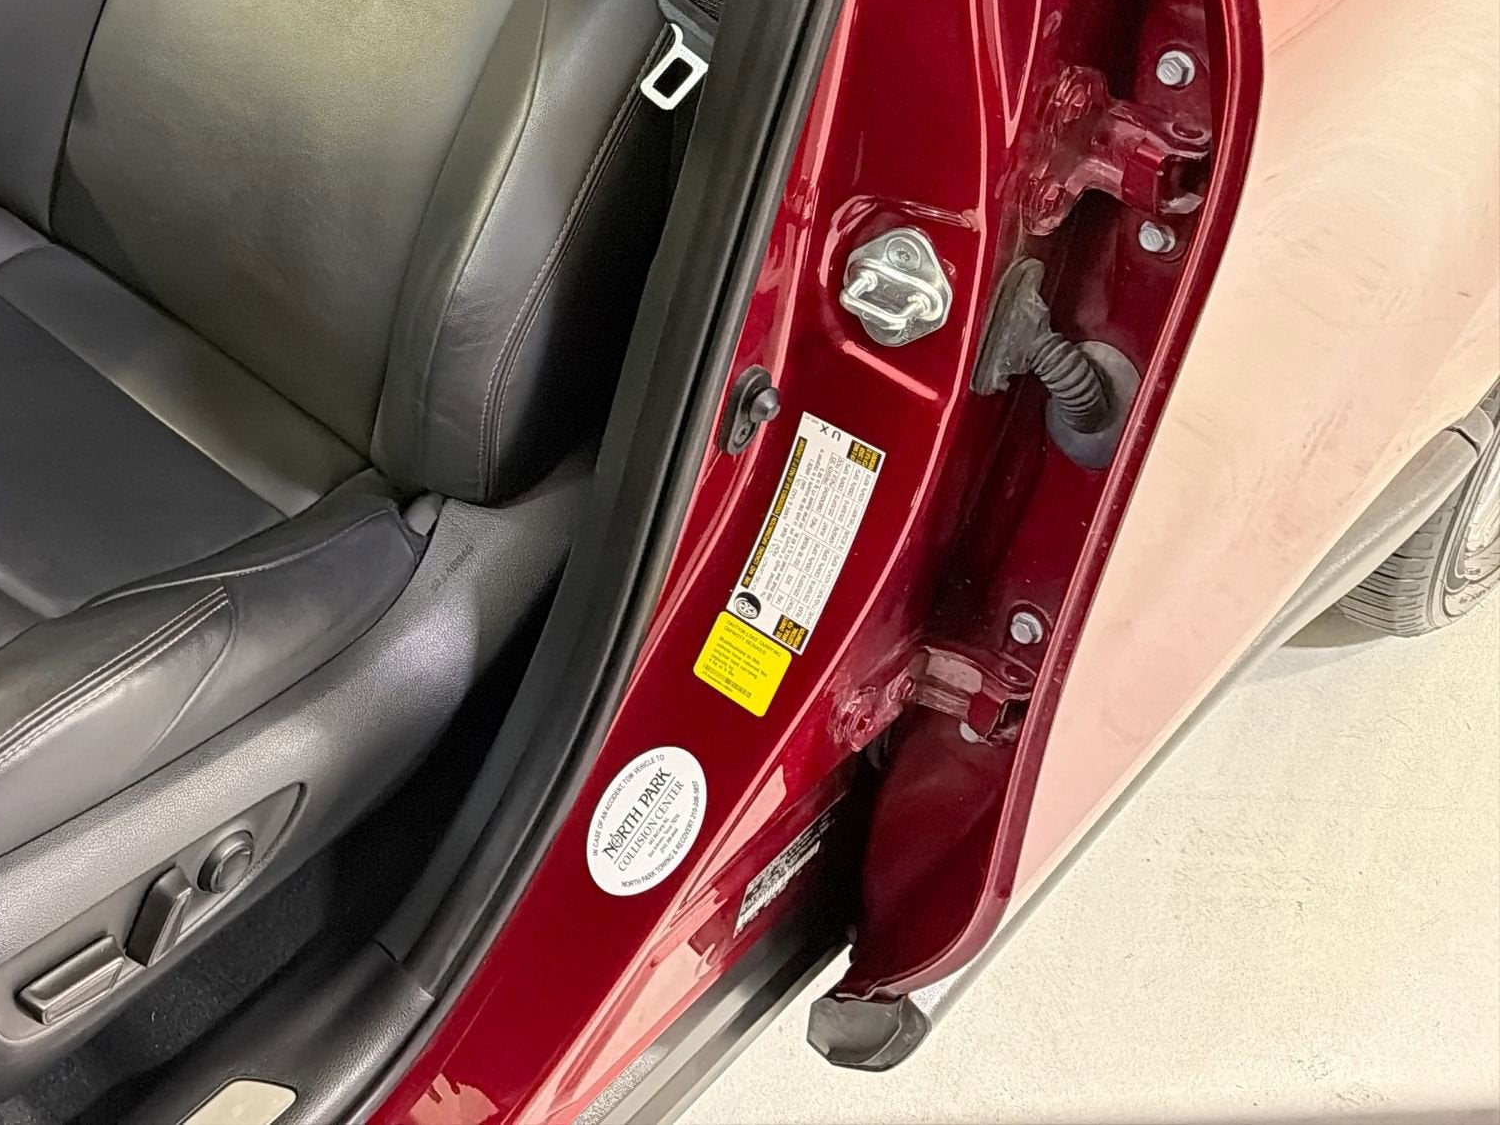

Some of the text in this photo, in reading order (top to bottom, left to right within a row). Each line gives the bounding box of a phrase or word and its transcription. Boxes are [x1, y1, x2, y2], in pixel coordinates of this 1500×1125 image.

[593, 830, 602, 846] CASE
[602, 767, 672, 859] NORTH PARK
[618, 781, 684, 872] COLLISION CENTER
[620, 878, 641, 886] NORTH
[640, 870, 656, 882] PARK
[654, 853, 674, 872] TOWING
[675, 819, 694, 850] RECOVERY
